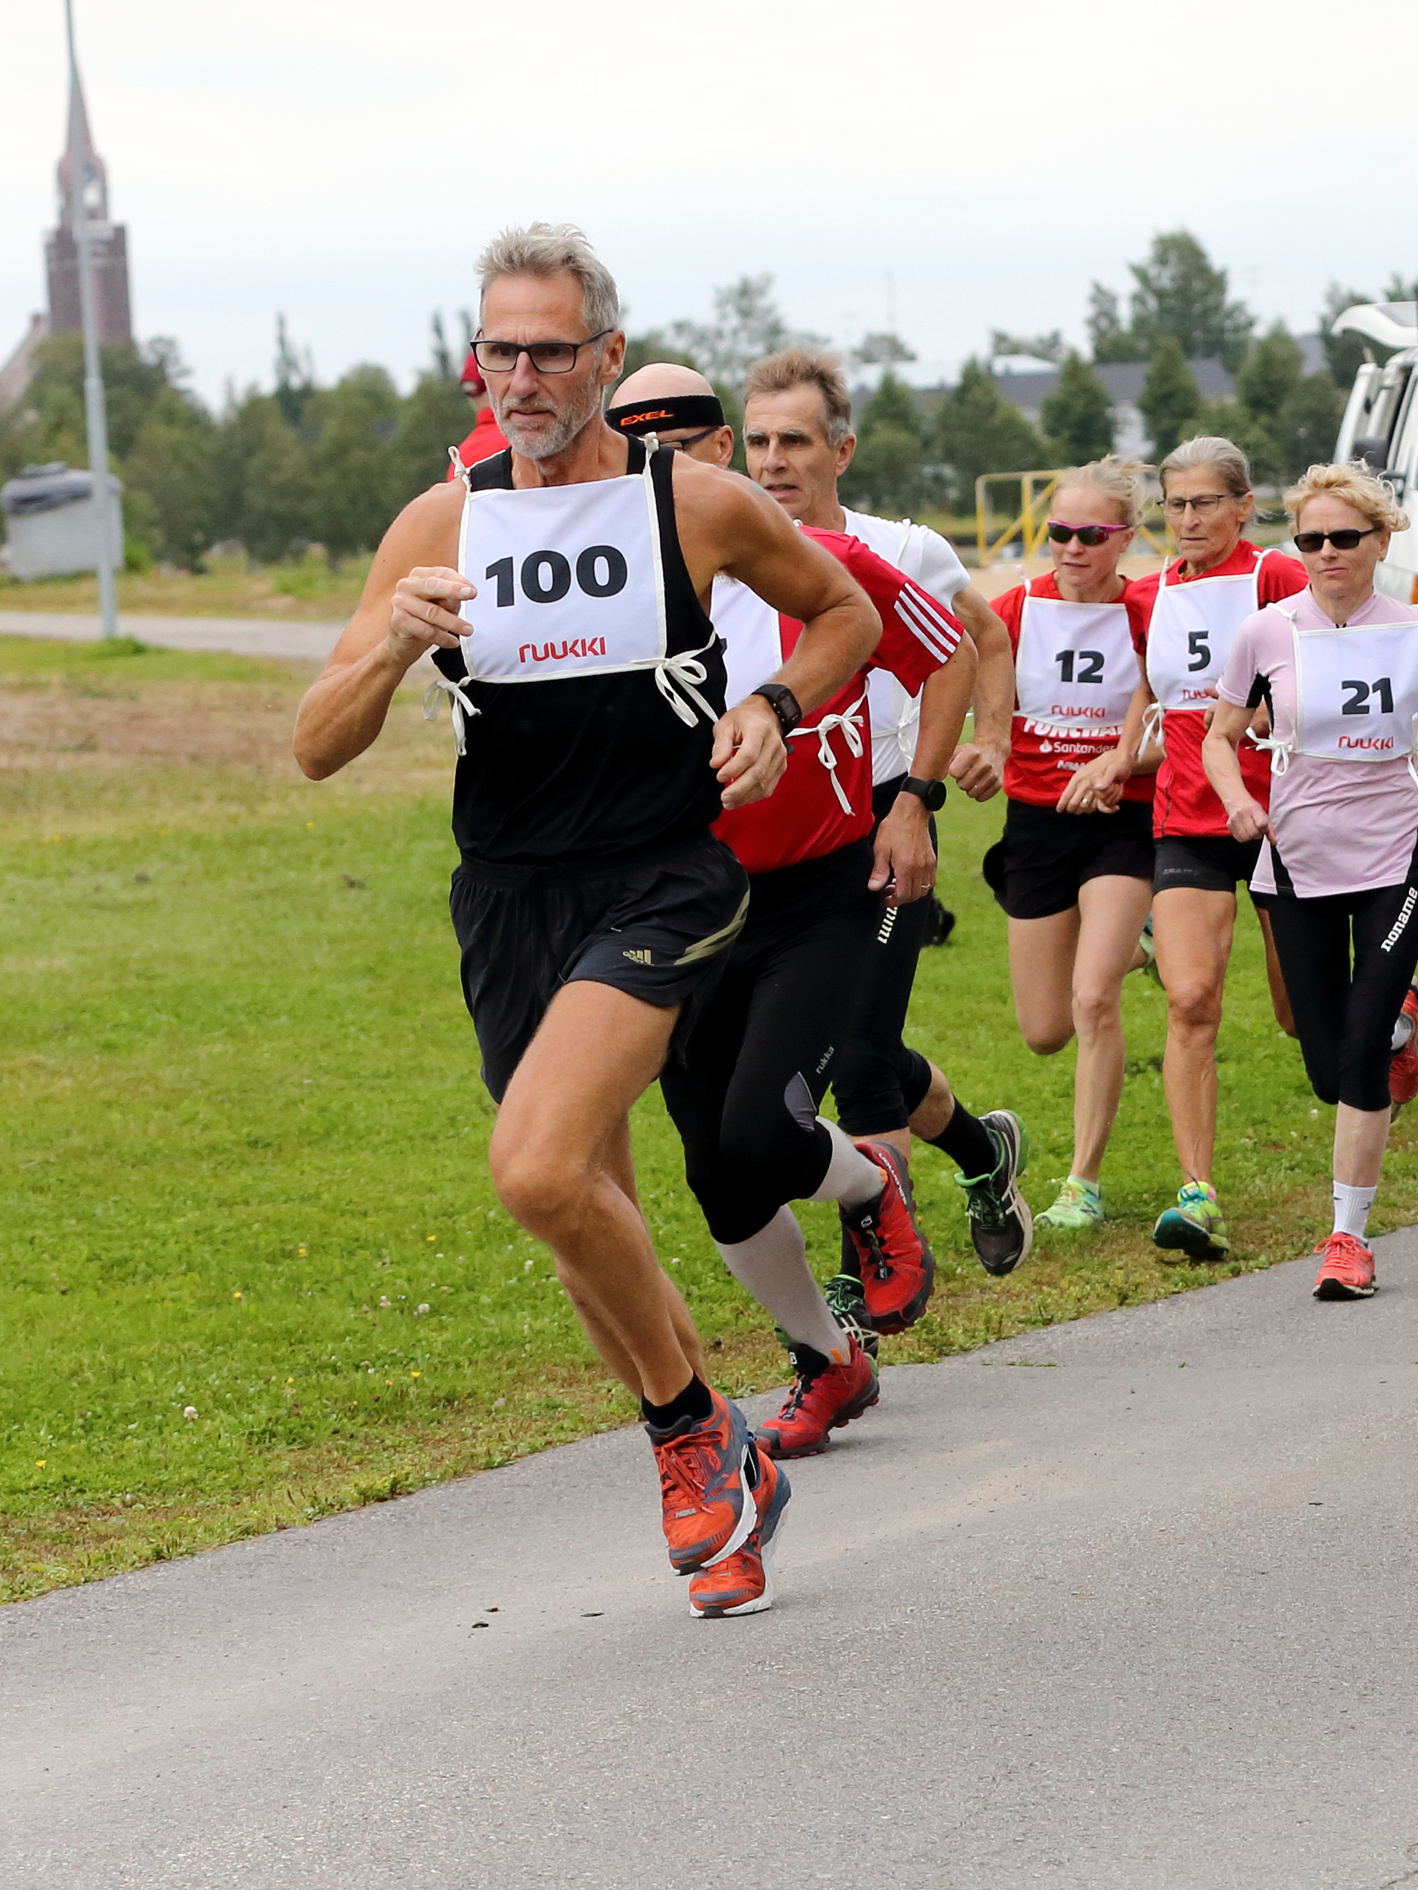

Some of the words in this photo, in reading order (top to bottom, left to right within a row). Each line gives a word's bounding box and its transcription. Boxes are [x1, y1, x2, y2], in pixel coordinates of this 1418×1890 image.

[620, 410, 674, 426] EXEL
[486, 545, 628, 608] 100
[1056, 650, 1105, 684] 12
[1188, 630, 1211, 671] 5
[1341, 677, 1394, 715] 21
[1053, 740, 1115, 754] Santander
[1380, 886, 1418, 953] noname
[815, 1046, 835, 1074] rukka
